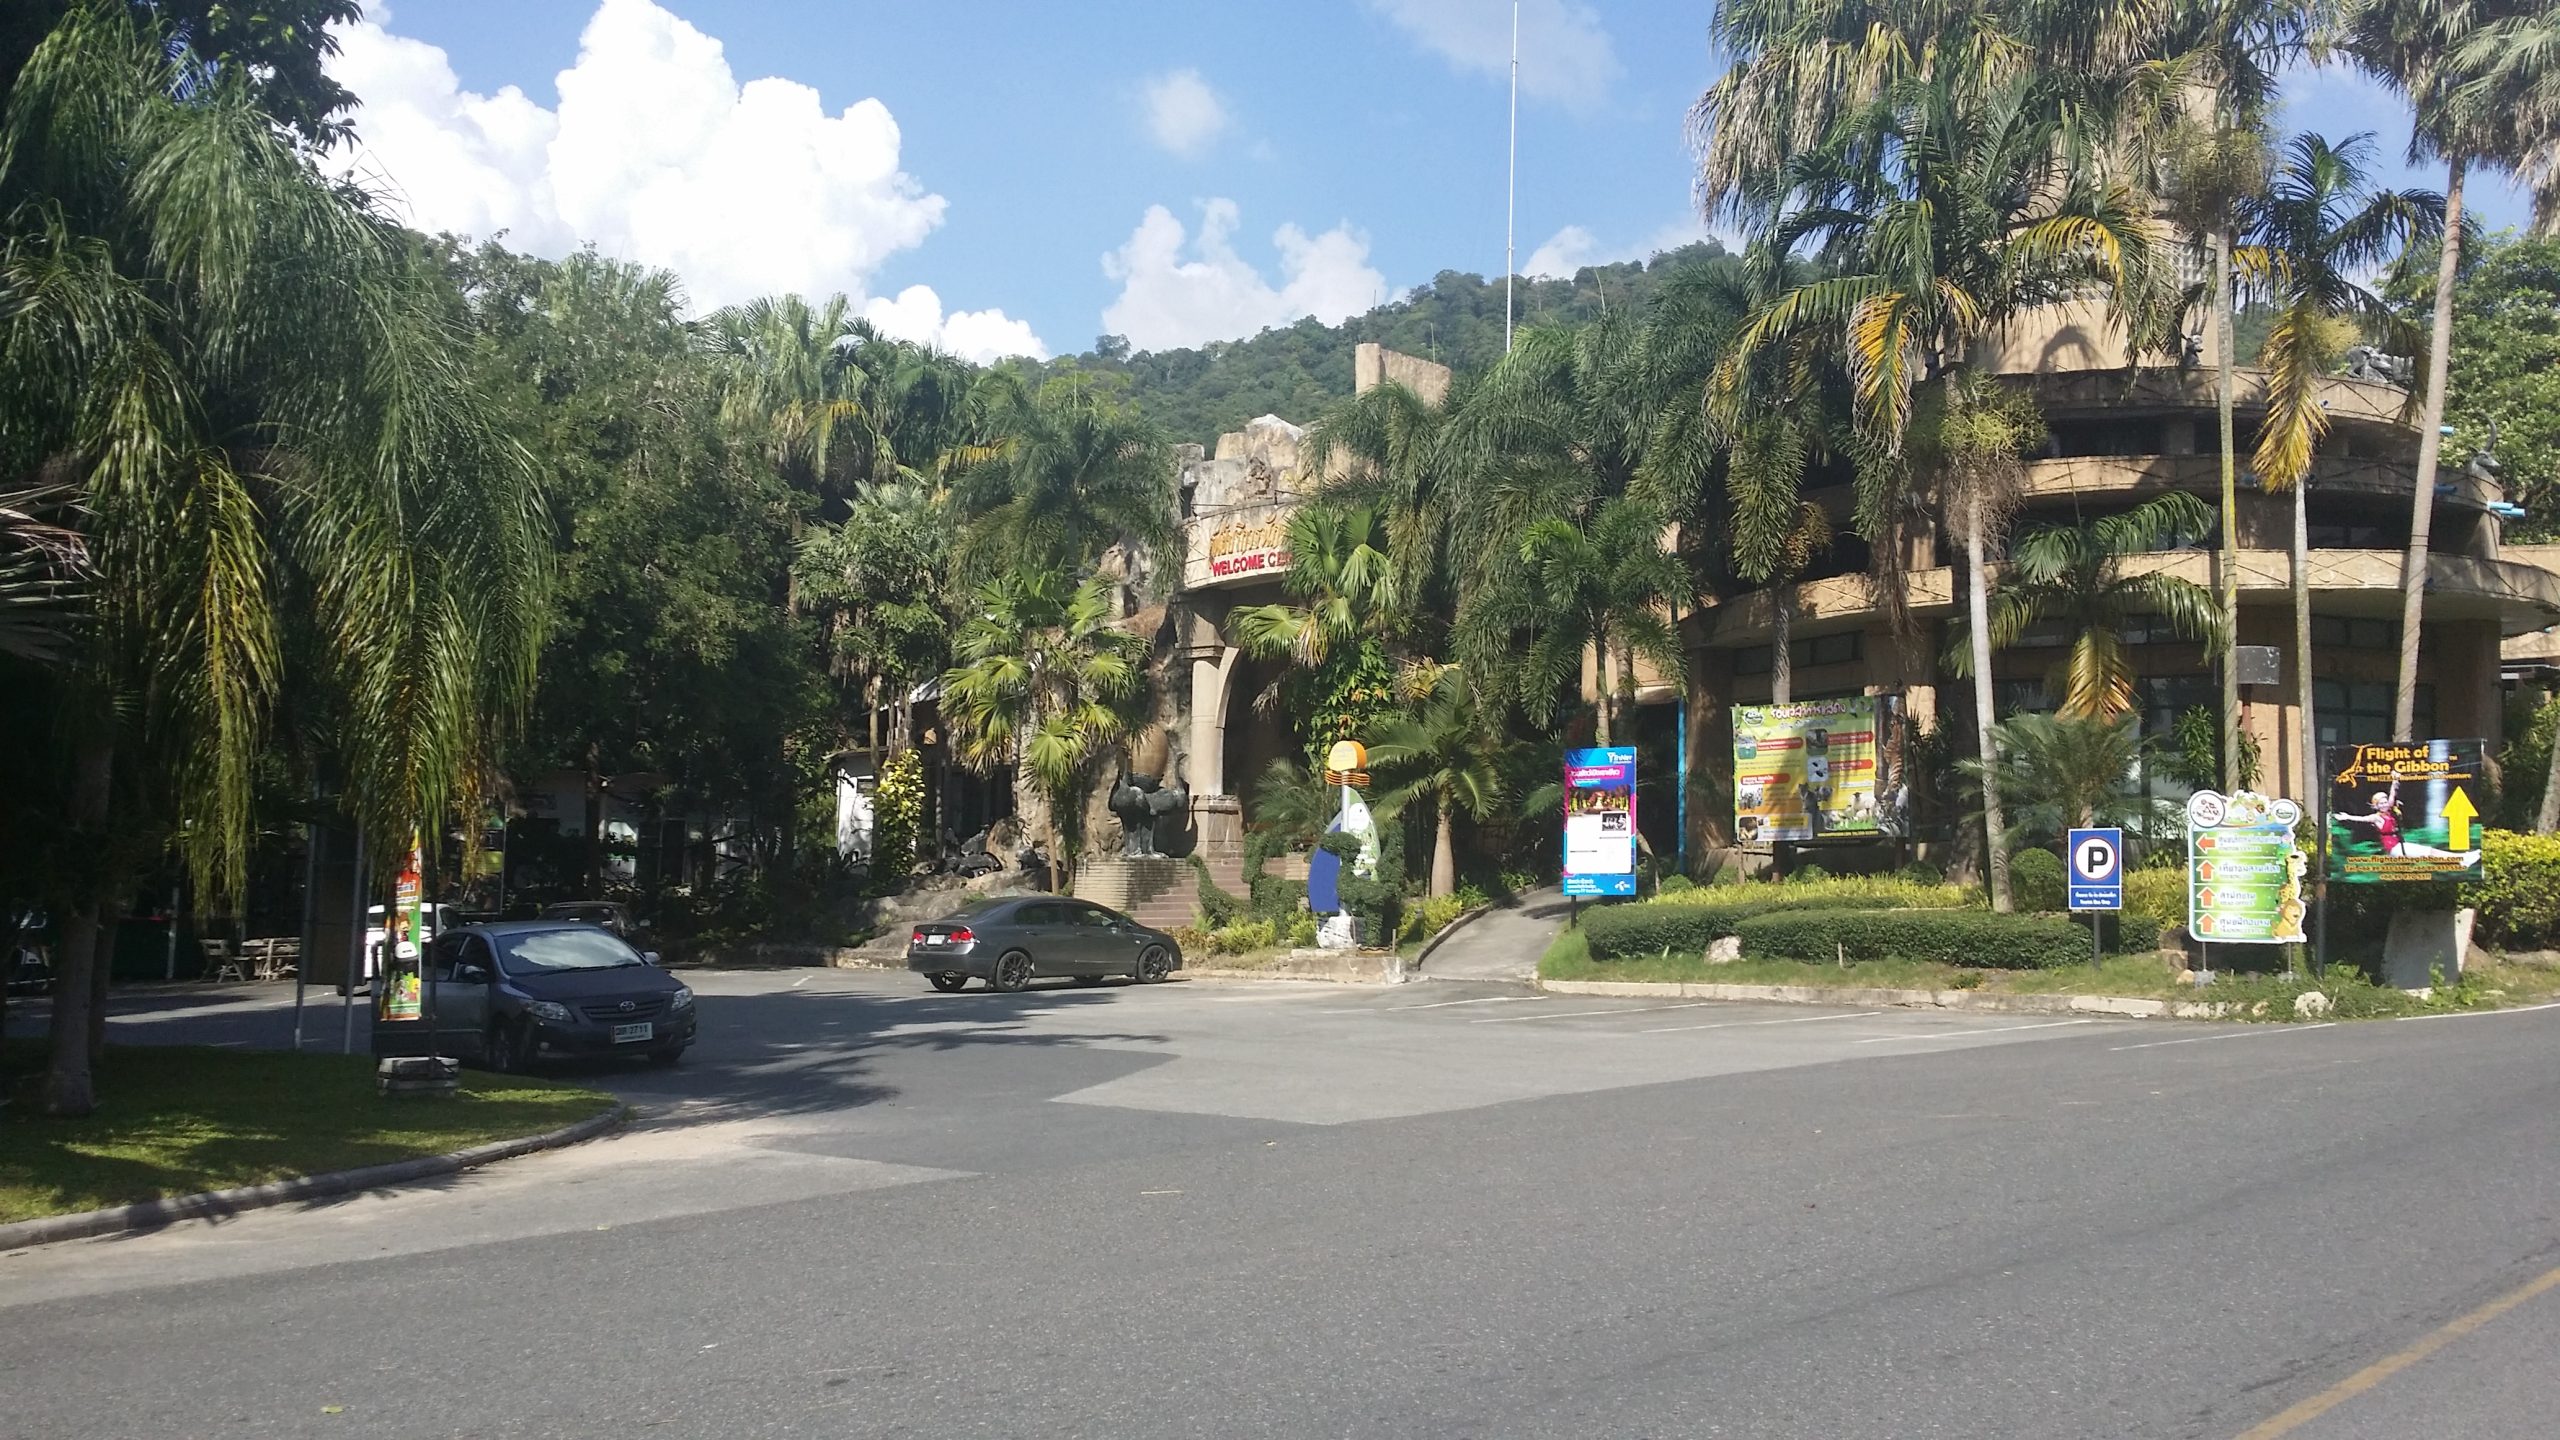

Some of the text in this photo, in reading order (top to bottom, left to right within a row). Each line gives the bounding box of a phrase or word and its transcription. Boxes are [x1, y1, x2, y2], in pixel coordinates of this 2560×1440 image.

[1211, 554, 1265, 577] WELCOME
[2366, 745, 2429, 761] Flight of
[2366, 760, 2450, 774] the Gibbon
[2087, 846, 2109, 873] P
[2347, 855, 2464, 863] www.flightofthegibbon.com
